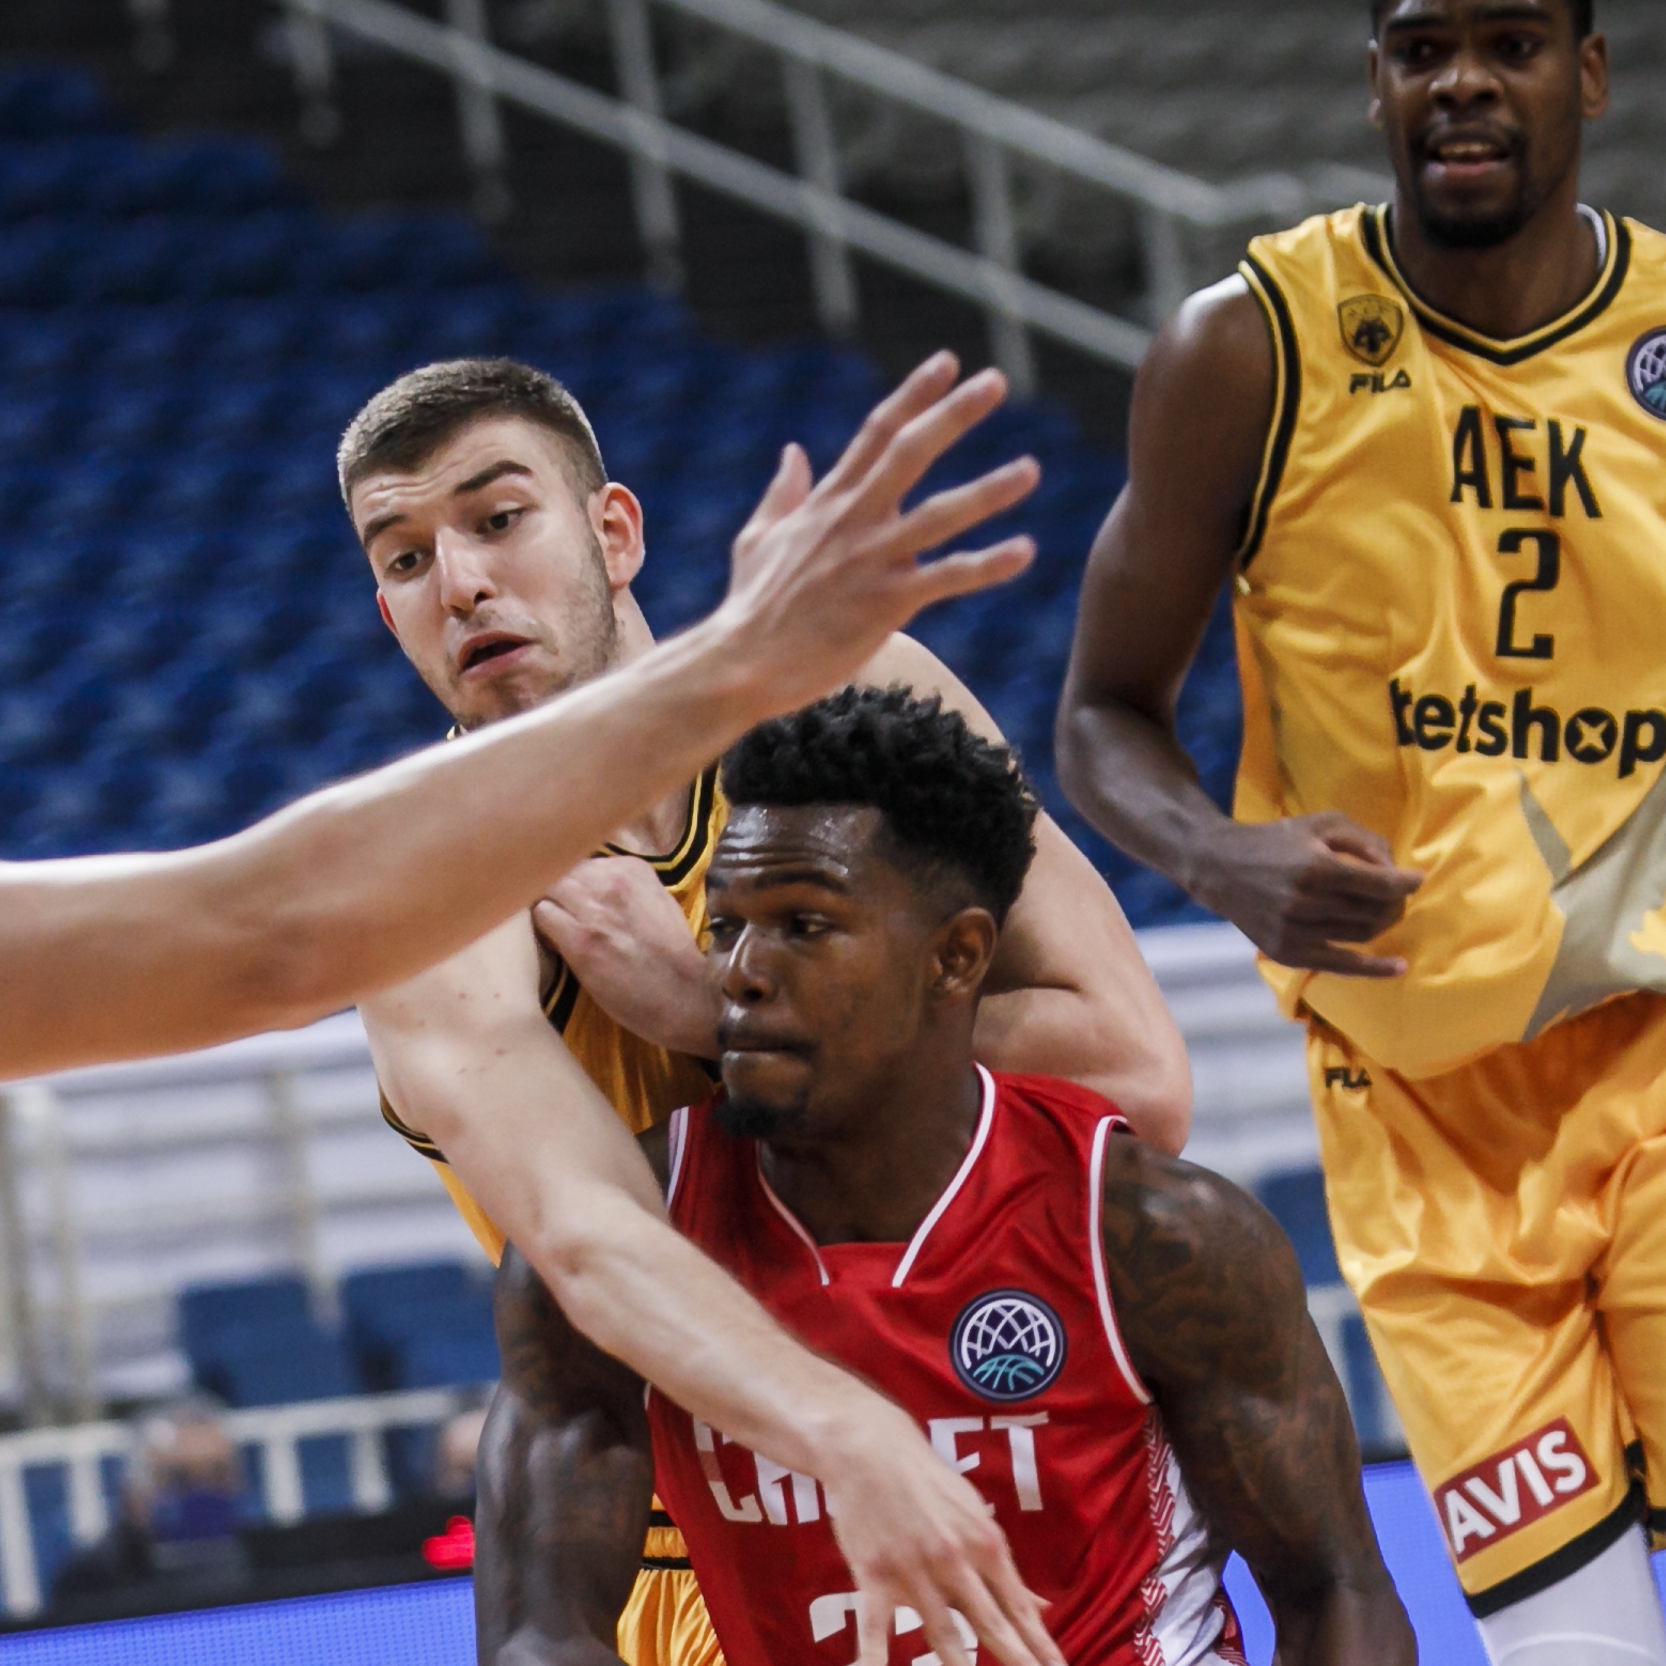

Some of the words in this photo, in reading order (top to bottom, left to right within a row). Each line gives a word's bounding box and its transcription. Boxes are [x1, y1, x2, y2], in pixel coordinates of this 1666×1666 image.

[1349, 368, 1412, 395] FILA
[1448, 404, 1603, 518] AEK
[1495, 527, 1561, 660] 2
[692, 1411, 1051, 1527] CHET
[1444, 1430, 1587, 1556] AVIS
